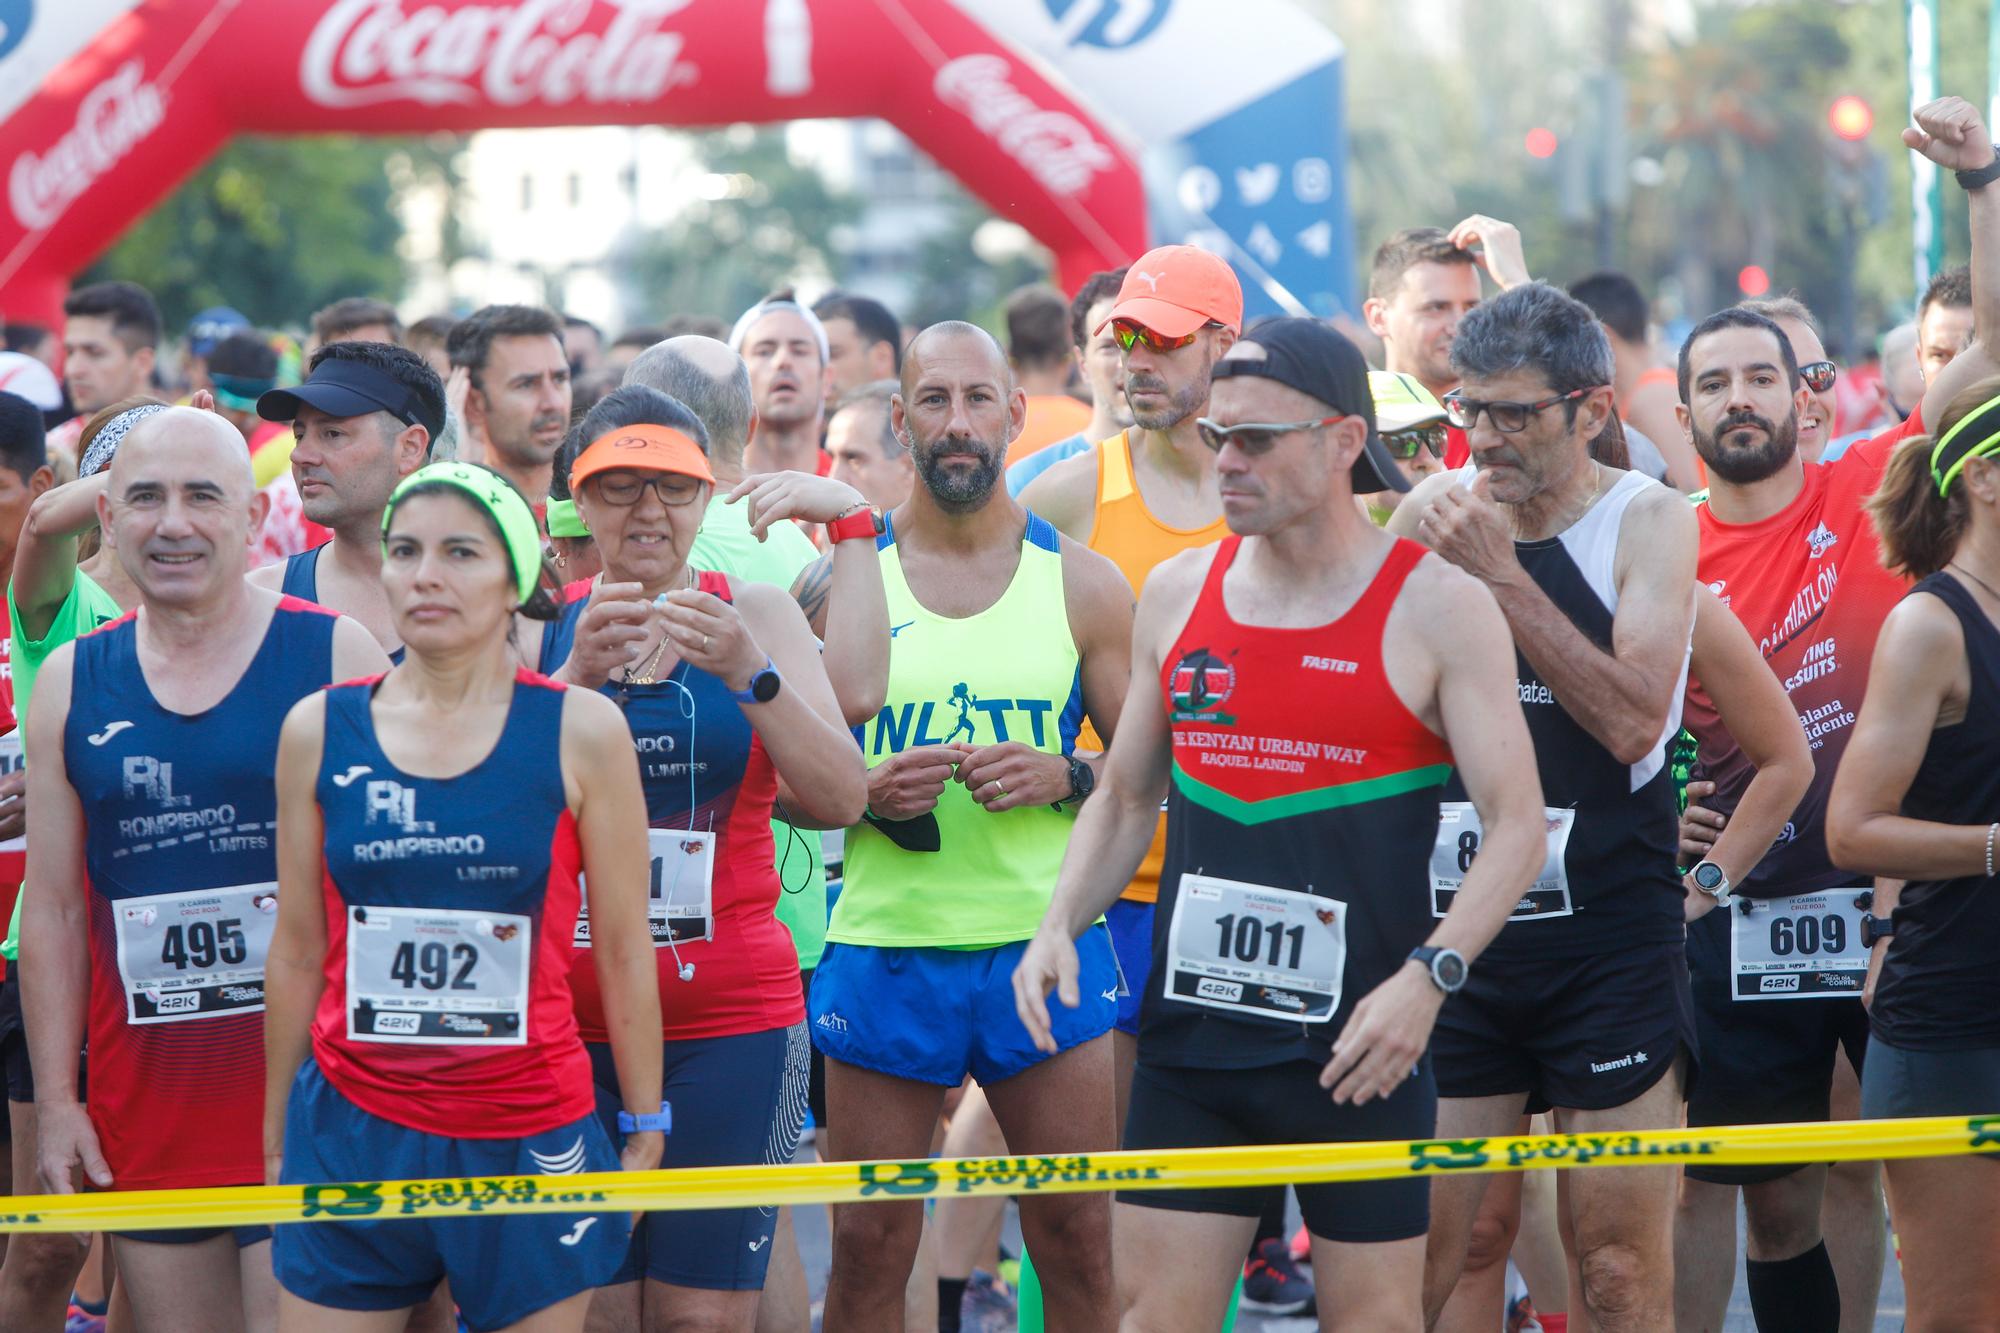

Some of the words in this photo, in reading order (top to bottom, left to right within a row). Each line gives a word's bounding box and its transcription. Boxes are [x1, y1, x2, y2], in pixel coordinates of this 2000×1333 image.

[1302, 655, 1359, 674] FASTER
[1800, 700, 1844, 727] alana
[1804, 711, 1856, 741] idente
[1187, 731, 1255, 752] KENYAN
[1259, 737, 1320, 759] URBAN
[1323, 745, 1367, 764] WAY
[1201, 752, 1252, 768] RAQUEL
[1253, 759, 1306, 774] LANDIN
[118, 804, 237, 839] ROMPIENDO
[208, 836, 269, 853] LIMITES
[352, 834, 486, 863] ROMPIENDO
[1797, 896, 1828, 904] CARRERA
[161, 918, 247, 970] 495
[1215, 913, 1305, 969] 1011
[1770, 914, 1846, 956] 609
[391, 941, 479, 990] 492
[1201, 983, 1239, 998] 42K
[1763, 978, 1796, 988] 42K
[160, 995, 196, 1008] 42K
[378, 1017, 416, 1029] 42K
[1591, 1054, 1633, 1073] luanvi
